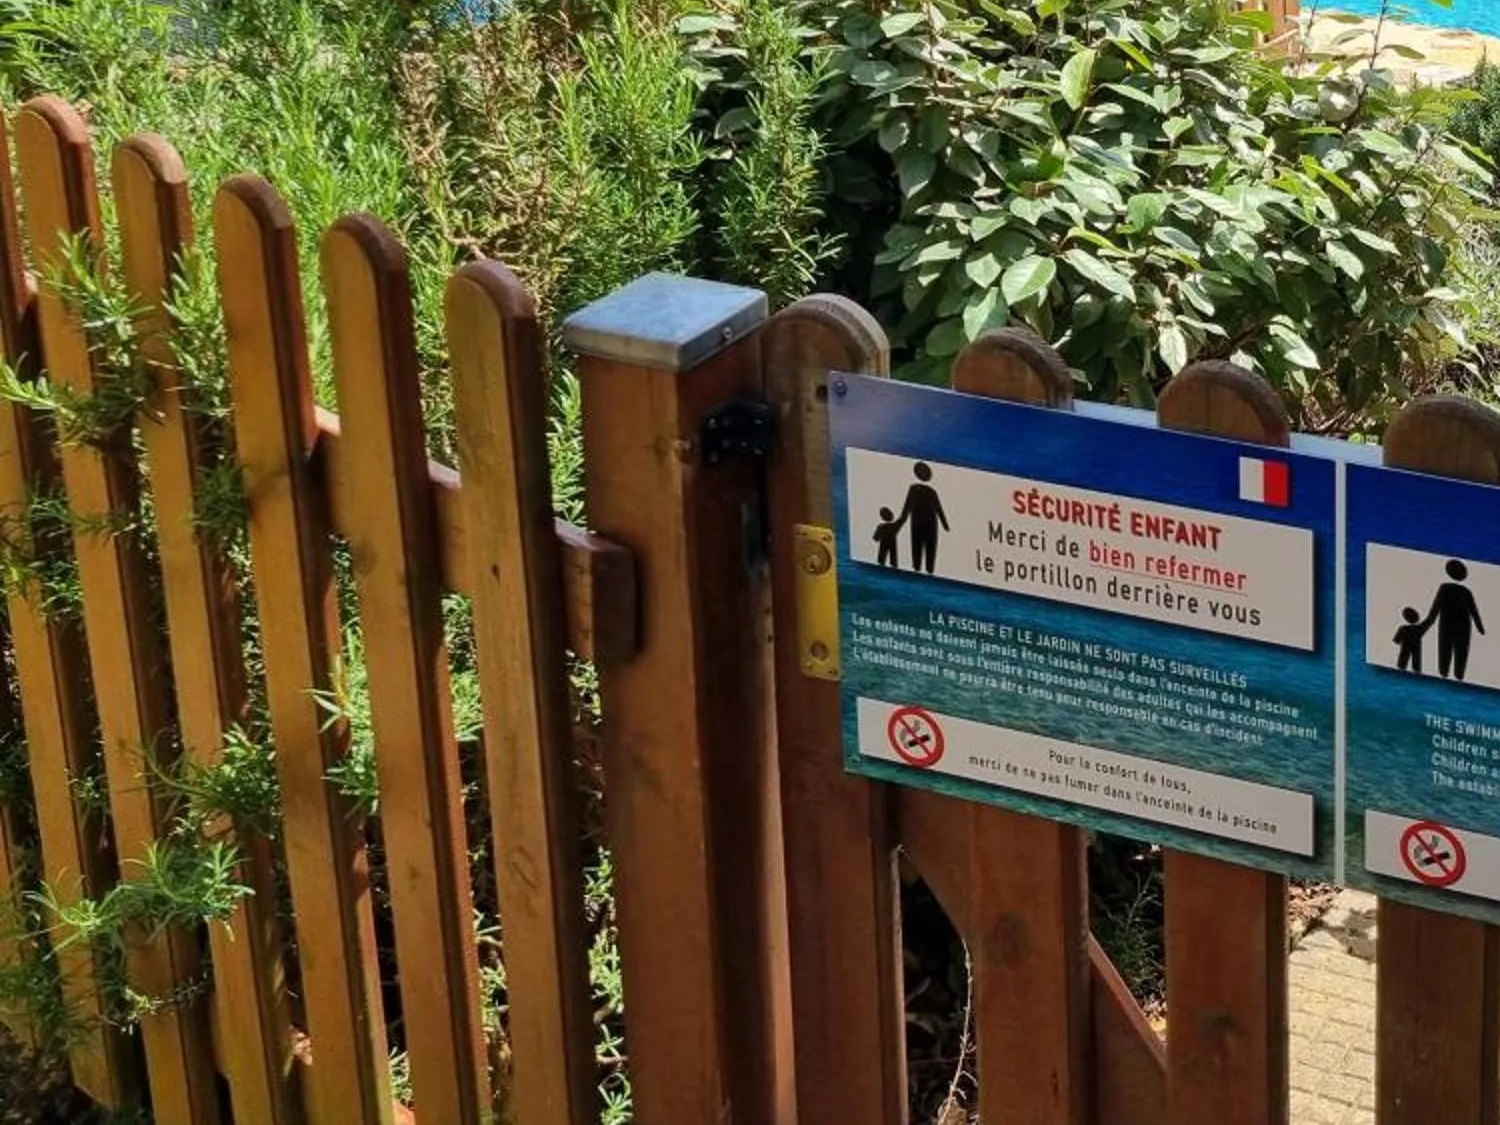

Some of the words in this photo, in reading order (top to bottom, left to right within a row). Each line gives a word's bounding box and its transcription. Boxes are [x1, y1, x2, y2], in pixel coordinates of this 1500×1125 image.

[1013, 489, 1121, 532] SÉCURITÉ
[1130, 511, 1222, 551] ENFANT
[989, 521, 1047, 552] Merci
[1056, 535, 1080, 558] de
[1089, 541, 1135, 569] bien
[1145, 556, 1247, 591] refermer
[976, 550, 994, 572] le
[1004, 559, 1097, 594] portillon
[1107, 577, 1198, 613] derrière
[1208, 599, 1261, 626] vous
[852, 612, 871, 627] Les
[875, 617, 915, 636] enfants
[919, 628, 933, 640] ne
[935, 629, 976, 649] doivent
[980, 638, 1017, 658] jamais
[1049, 651, 1089, 673] laissés
[1093, 664, 1124, 681] seuls
[1129, 670, 1156, 688] dans
[1221, 690, 1235, 704] de
[1239, 693, 1250, 707] la
[1255, 698, 1300, 718] piscine
[929, 611, 945, 625] LA
[949, 616, 996, 636] PISCINE
[1000, 625, 1013, 639] ET
[1017, 629, 1032, 644] LE
[1036, 634, 1080, 654] JARDIN
[1084, 643, 1101, 658] NE
[1105, 647, 1137, 665] SONT
[1141, 654, 1165, 671] PAS
[1169, 660, 1247, 688] SURVEILLÉS
[853, 631, 872, 645] Les
[875, 636, 916, 655] enfants
[920, 645, 944, 660] sont
[949, 652, 974, 667] sous
[977, 655, 1022, 677] l'entière
[1113, 684, 1134, 700] des
[1138, 689, 1181, 712] adultes
[1185, 702, 1203, 717] qui
[1207, 703, 1225, 720] les
[1230, 711, 1317, 740] accompagnent
[943, 667, 956, 680] ne
[1027, 684, 1053, 700] tenu
[1057, 692, 1082, 708] pour
[1086, 697, 1157, 724] responsable
[1424, 714, 1451, 732] THE
[1432, 734, 1487, 757] Children
[969, 754, 1001, 771] merci
[1005, 760, 1019, 774] de
[1023, 766, 1037, 779] ne
[1040, 769, 1061, 785] pas
[1065, 774, 1100, 793] fumer
[1103, 783, 1131, 802] dans
[1198, 806, 1213, 820] de
[1217, 809, 1228, 824] la
[1233, 814, 1277, 834] piscine
[1049, 749, 1075, 766] Pour
[1079, 755, 1090, 770] la
[1096, 761, 1138, 782] confort
[1143, 771, 1157, 786] de
[1432, 752, 1487, 776] Children
[1432, 770, 1452, 787] The
